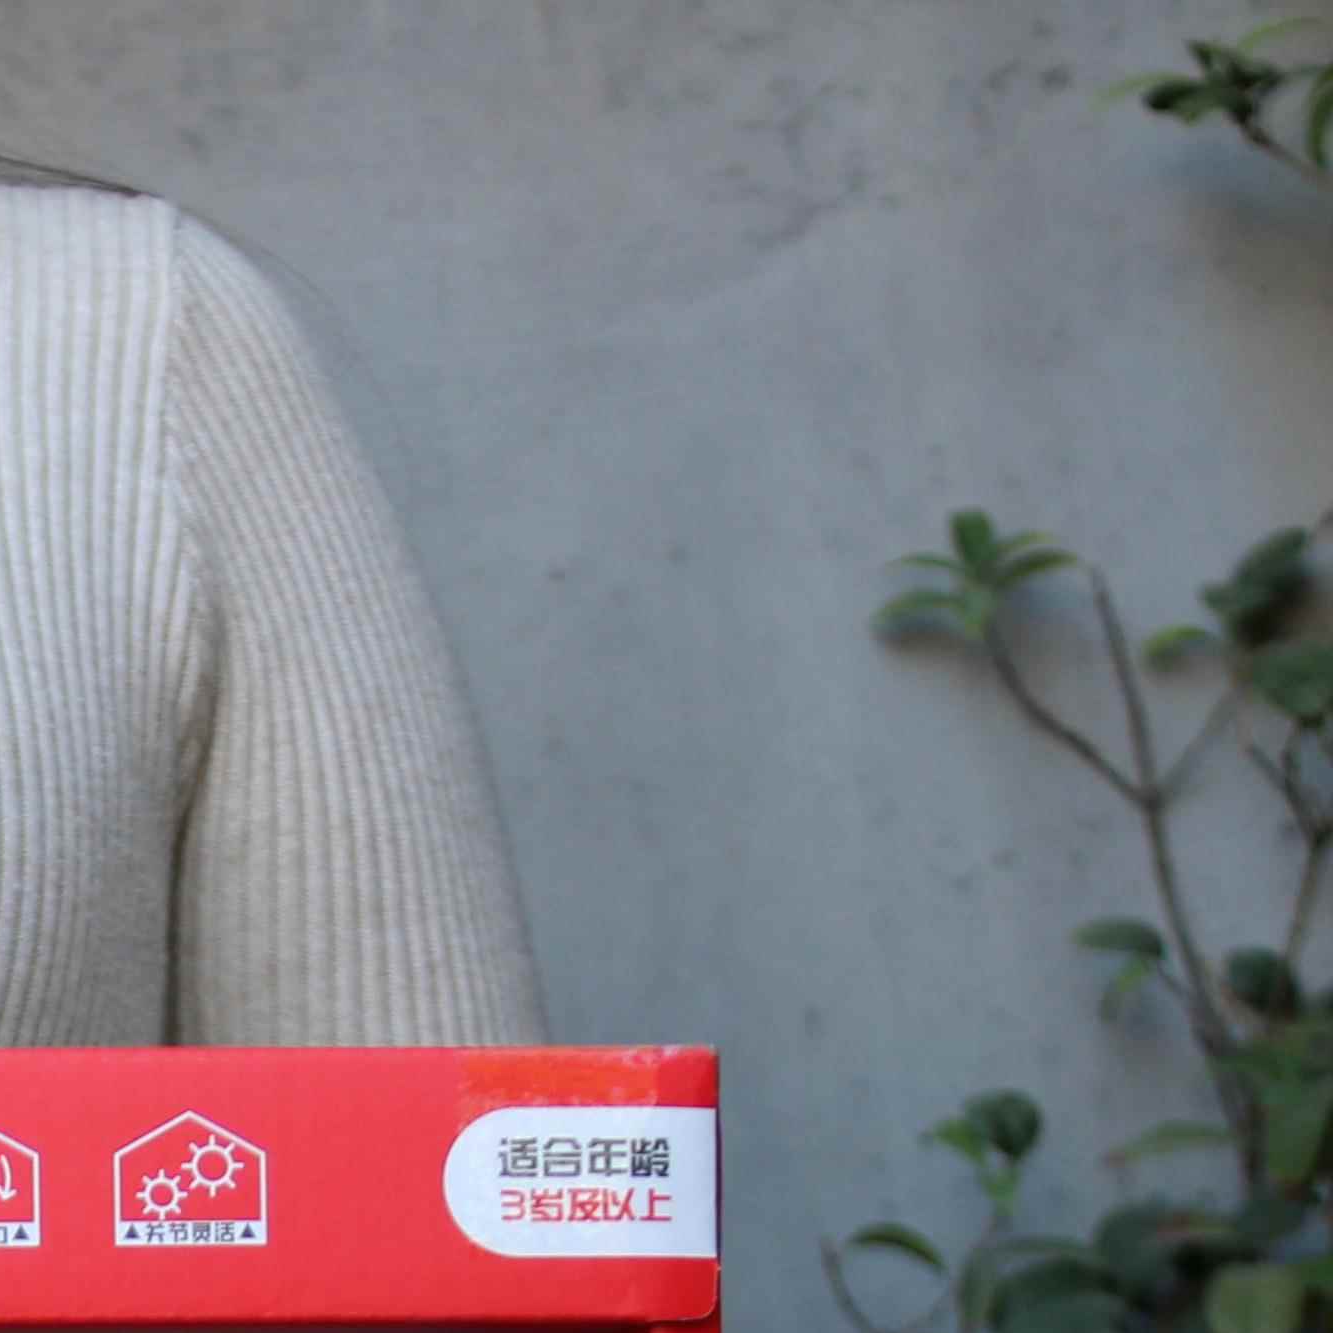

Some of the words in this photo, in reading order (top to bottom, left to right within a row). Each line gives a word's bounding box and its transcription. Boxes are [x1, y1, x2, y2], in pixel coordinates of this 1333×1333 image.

[498, 1137, 670, 1178] 适合年龄
[499, 1188, 672, 1222] 3岁及以上
[145, 1221, 236, 1243] 关节灵活
